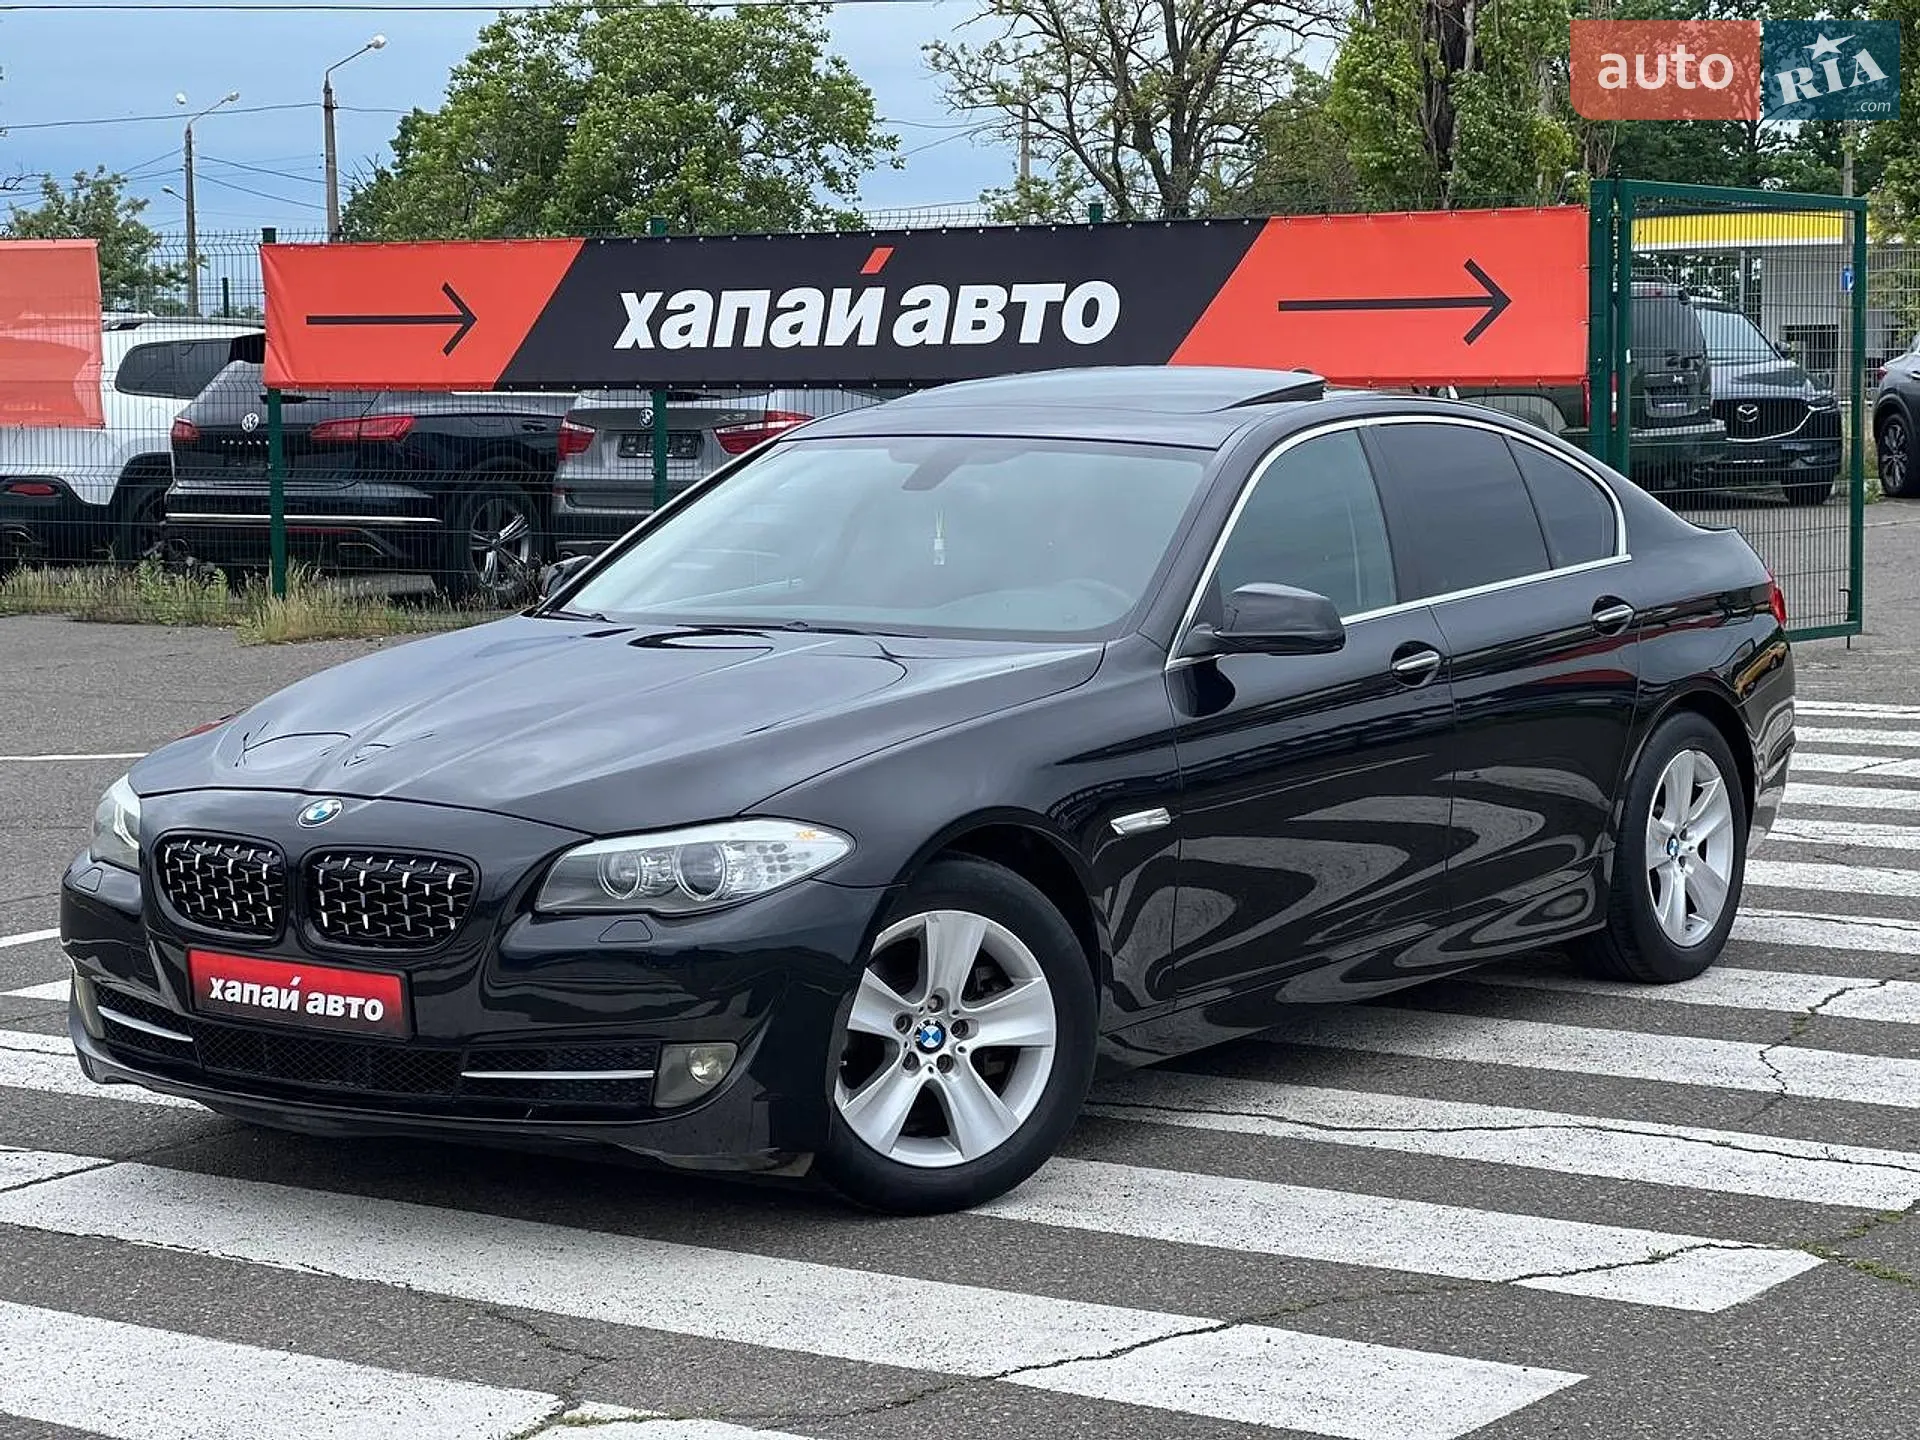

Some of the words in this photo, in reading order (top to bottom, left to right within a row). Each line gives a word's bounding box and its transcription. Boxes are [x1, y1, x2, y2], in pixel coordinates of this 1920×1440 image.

[892, 280, 1121, 347] авто
[209, 976, 302, 1012] хапай
[305, 991, 384, 1022] авто
